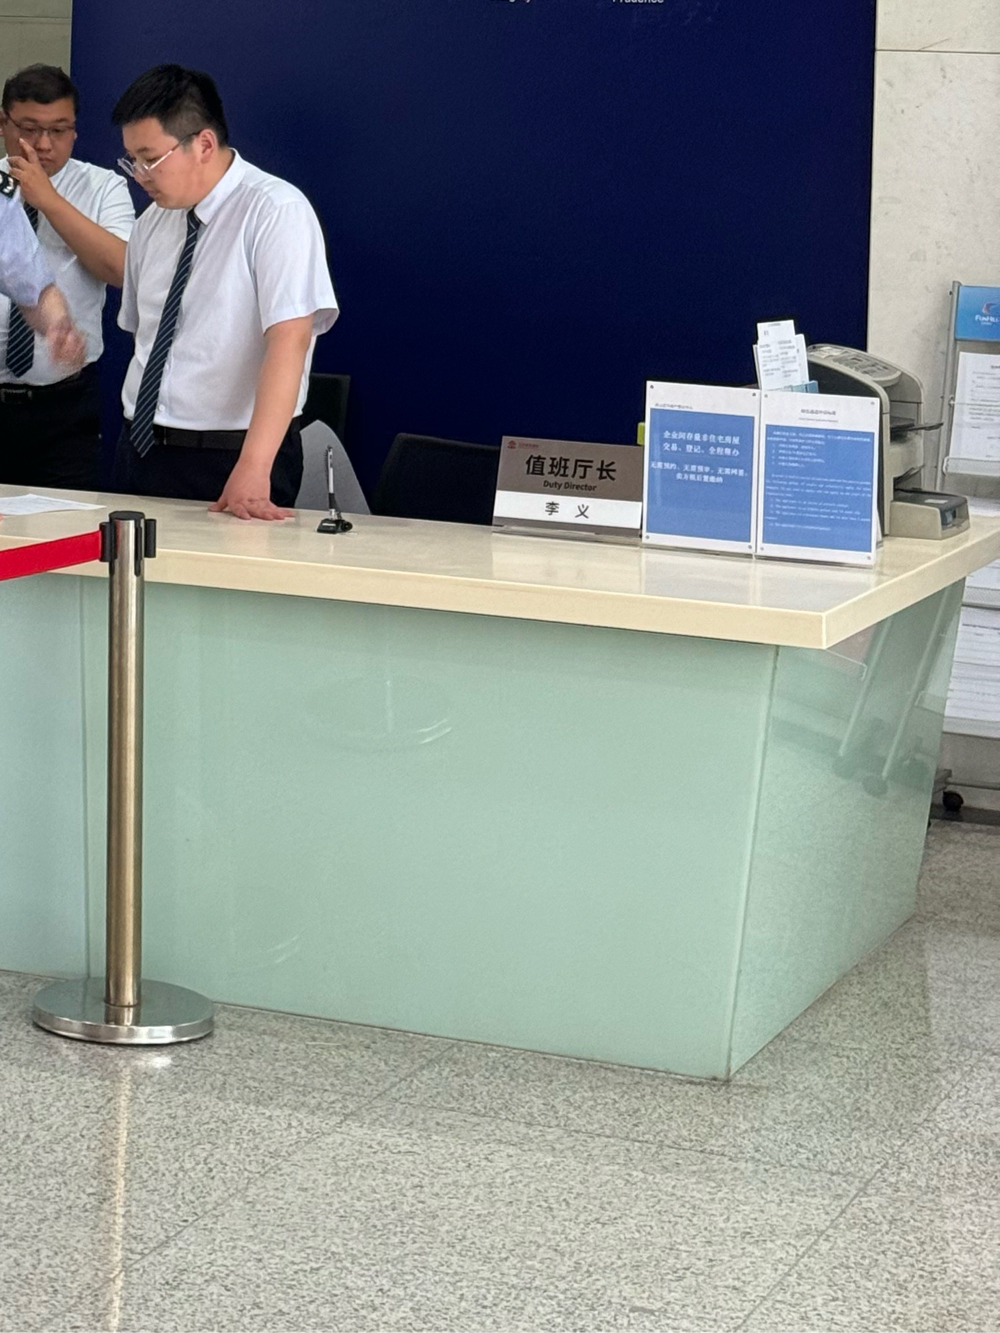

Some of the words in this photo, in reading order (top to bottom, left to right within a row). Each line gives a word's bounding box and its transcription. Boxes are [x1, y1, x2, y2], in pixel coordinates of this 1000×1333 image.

[525, 454, 617, 481] 值班厅长
[543, 480, 563, 491] Duty
[564, 481, 598, 492] Director
